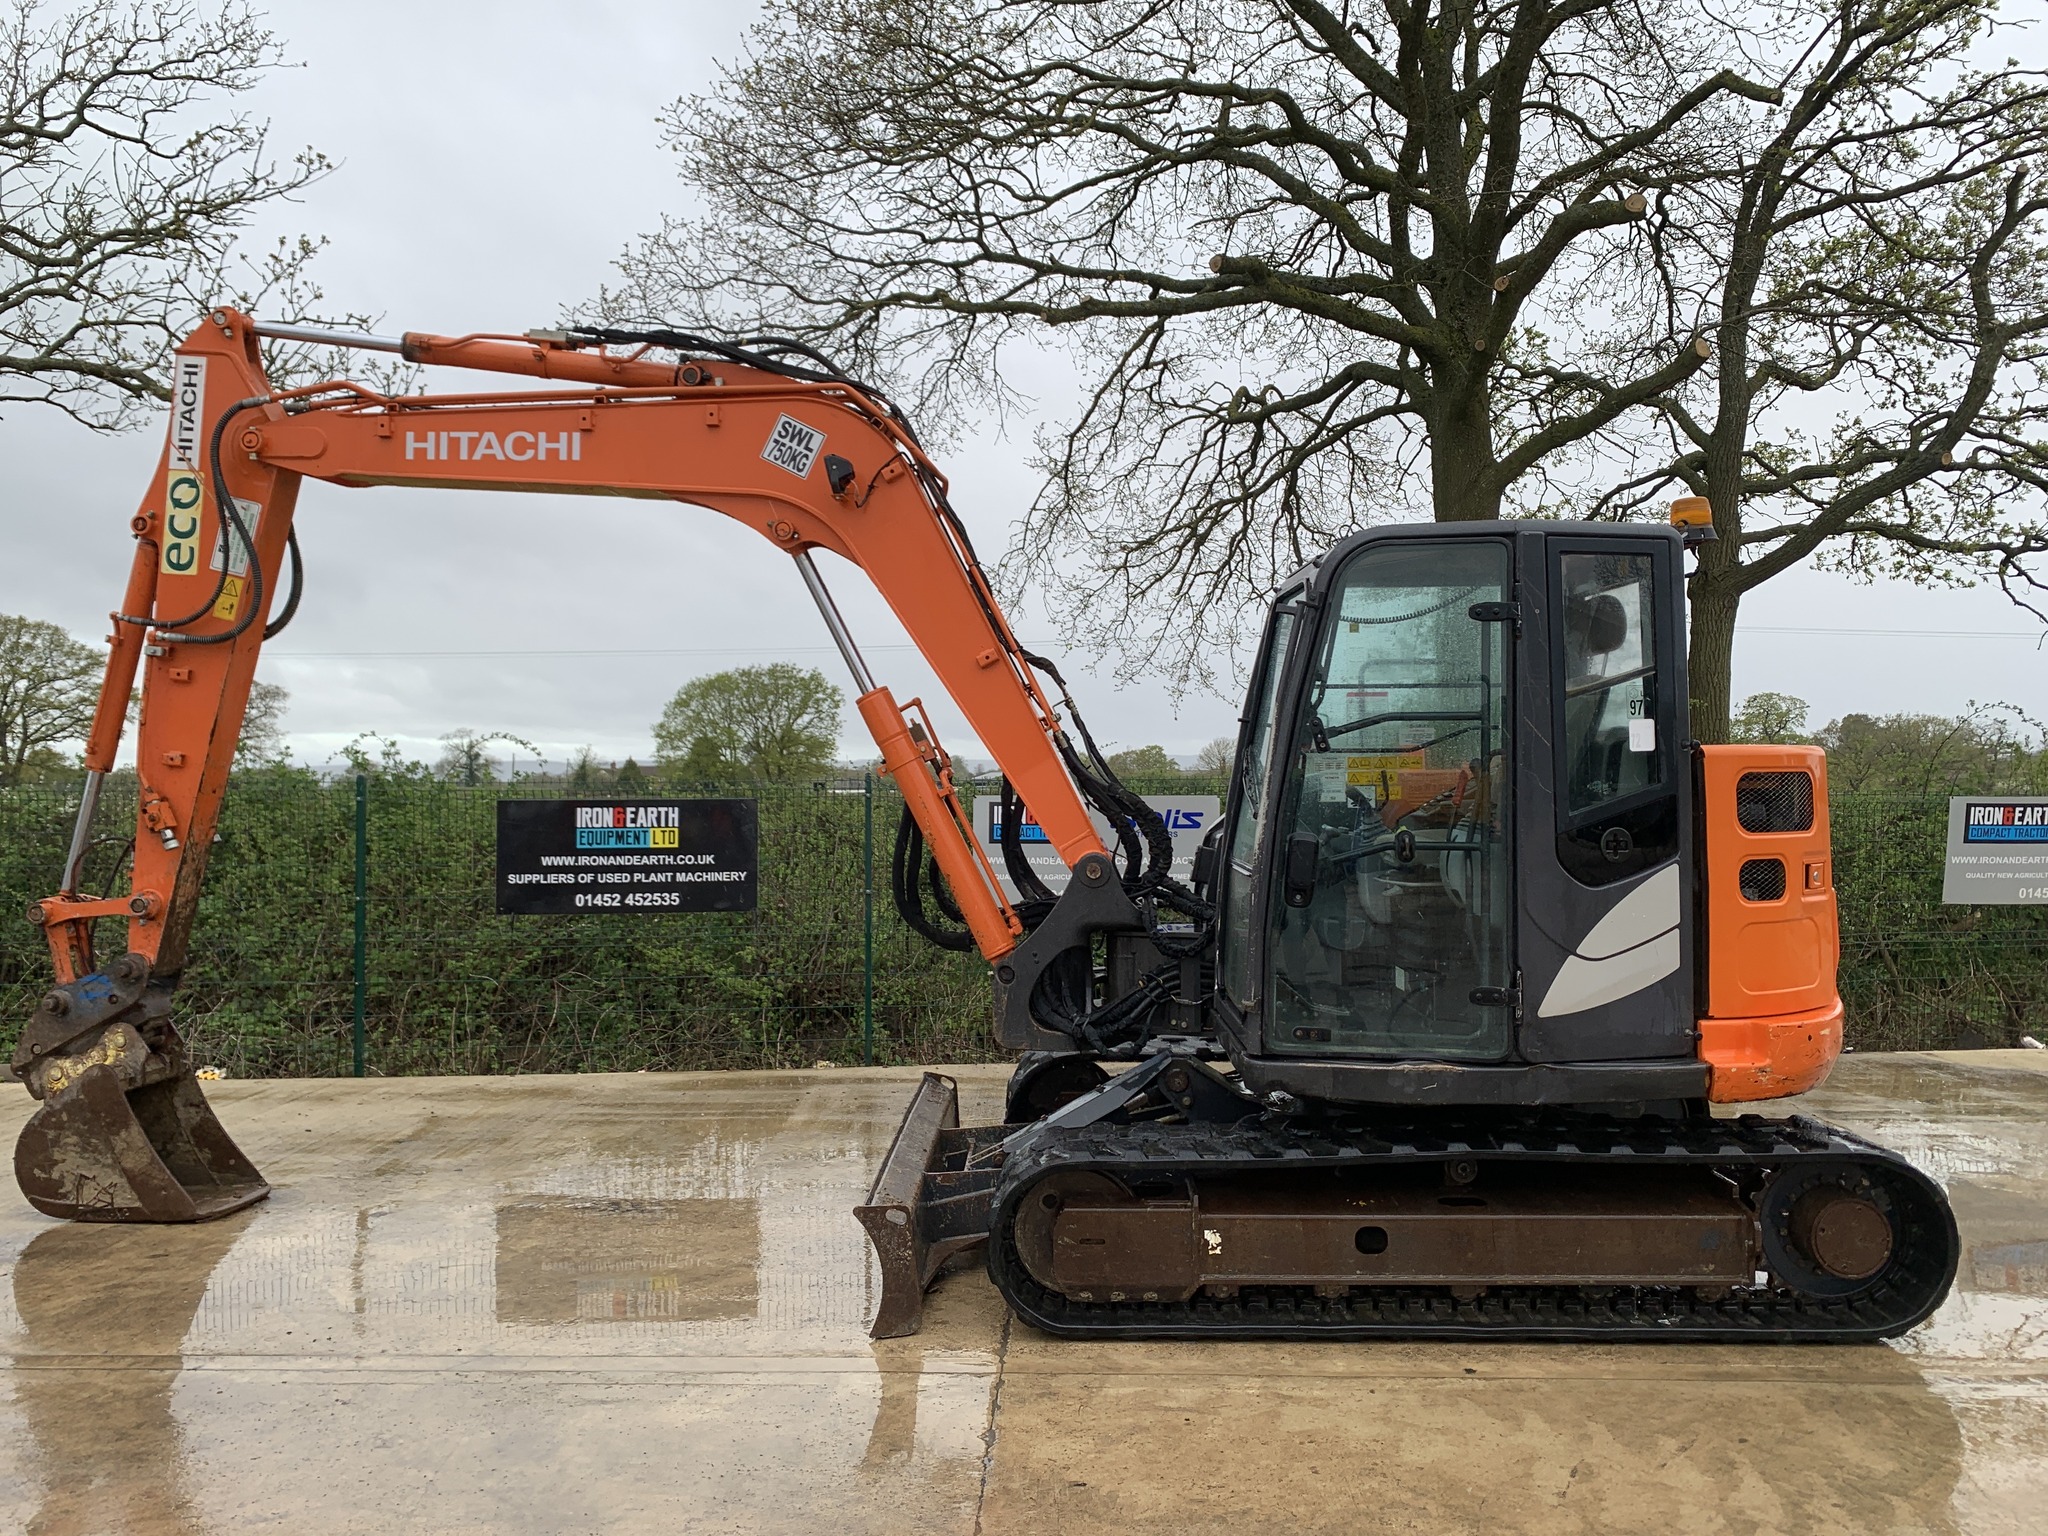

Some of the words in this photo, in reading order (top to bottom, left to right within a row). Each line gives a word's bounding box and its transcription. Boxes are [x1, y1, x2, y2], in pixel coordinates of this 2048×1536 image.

[177, 363, 199, 462] HITACHI
[777, 420, 815, 453] SWL
[405, 431, 581, 461] HITACHI
[767, 438, 809, 473] 750KG
[1629, 699, 1644, 716] 97
[576, 806, 679, 828] IRON&EARTH
[579, 830, 649, 847] EQUIPMENT
[652, 830, 676, 845] LTD
[1971, 827, 2010, 838] COMPACT
[541, 855, 715, 866] WWW.IRONANDEARTH.CO.UK
[507, 874, 575, 884] SUPPLIERS
[577, 873, 595, 883] OF
[597, 873, 631, 883] USED
[633, 872, 673, 882] PLANT
[676, 871, 747, 882] MACHINERY
[575, 894, 621, 907] 01452
[624, 893, 680, 906] 452535
